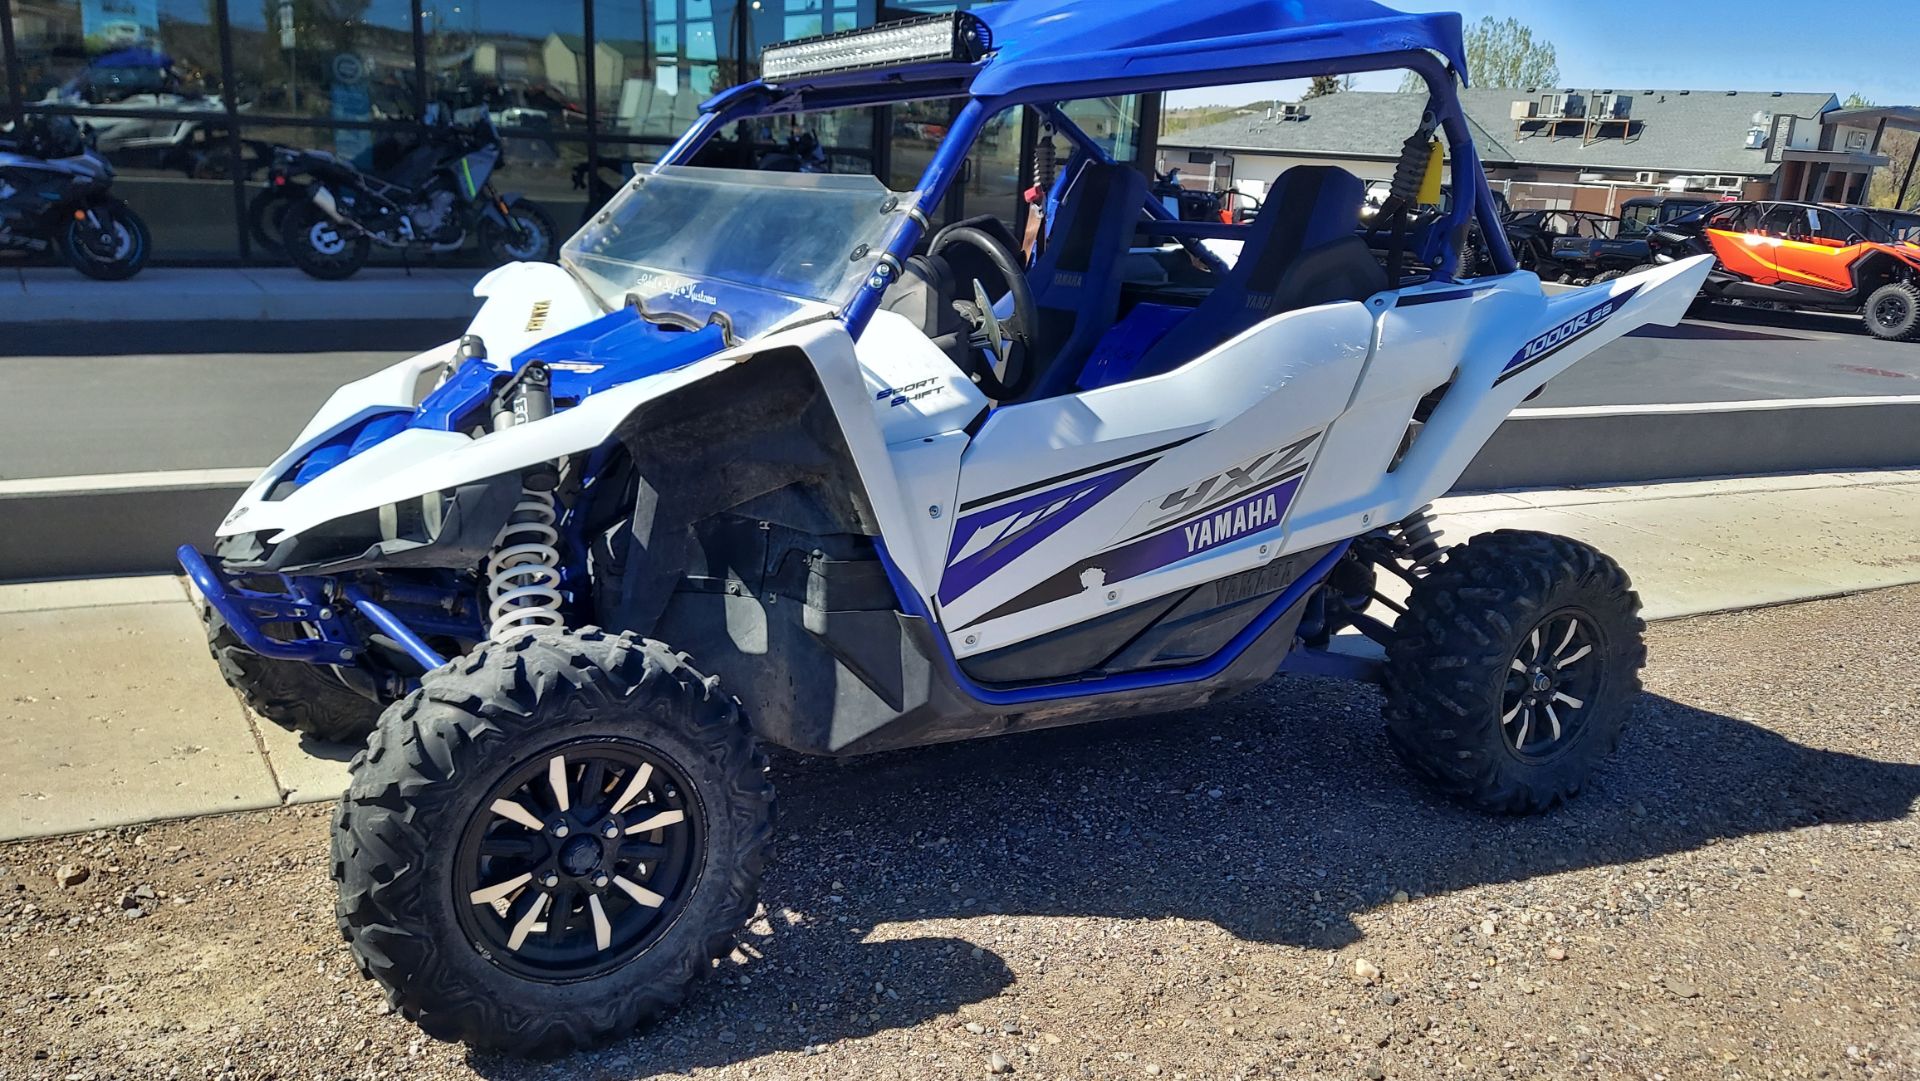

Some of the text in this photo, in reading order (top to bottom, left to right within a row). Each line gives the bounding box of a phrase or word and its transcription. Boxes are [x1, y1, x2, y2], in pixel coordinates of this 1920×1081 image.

[684, 282, 717, 305] Kustoms
[1055, 272, 1082, 288] YAMAHA
[524, 300, 552, 332] YAMAHA
[1523, 302, 1613, 358] 1000R SS
[876, 376, 939, 400] SPORT
[890, 385, 945, 407] SHIFT
[1148, 430, 1323, 526] YXZ
[1184, 493, 1277, 553] YAMAHA
[1215, 560, 1296, 606] YAMAHA
